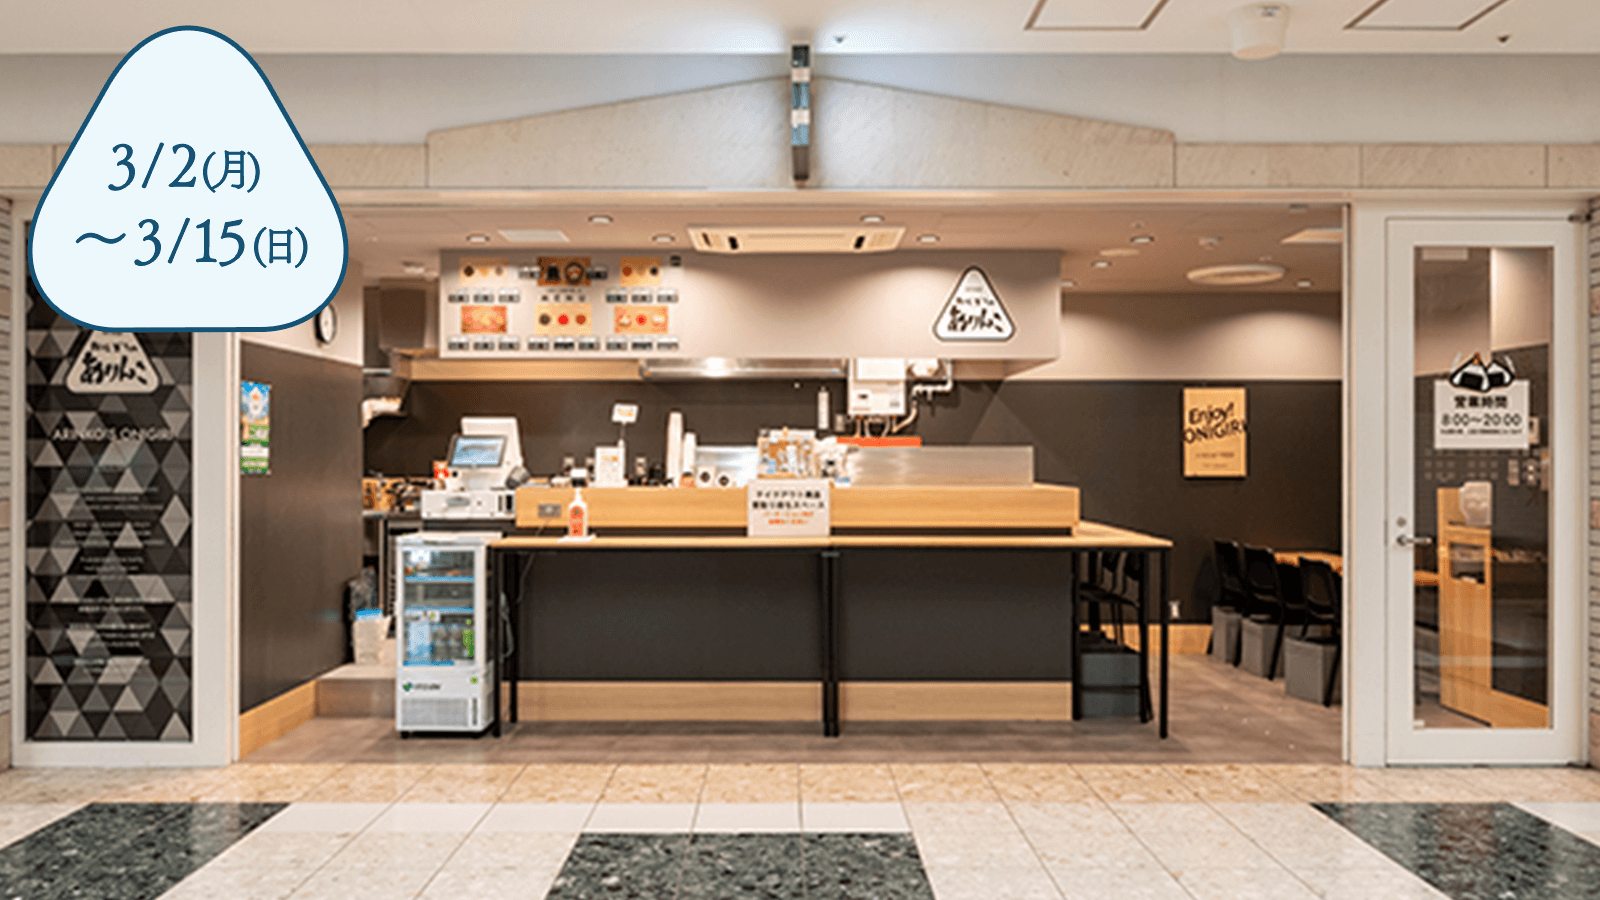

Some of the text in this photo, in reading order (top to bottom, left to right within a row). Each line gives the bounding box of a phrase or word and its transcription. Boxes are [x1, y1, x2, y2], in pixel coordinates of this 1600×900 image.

[947, 305, 1004, 332] ありんこ
[80, 351, 148, 385] ありんこ
